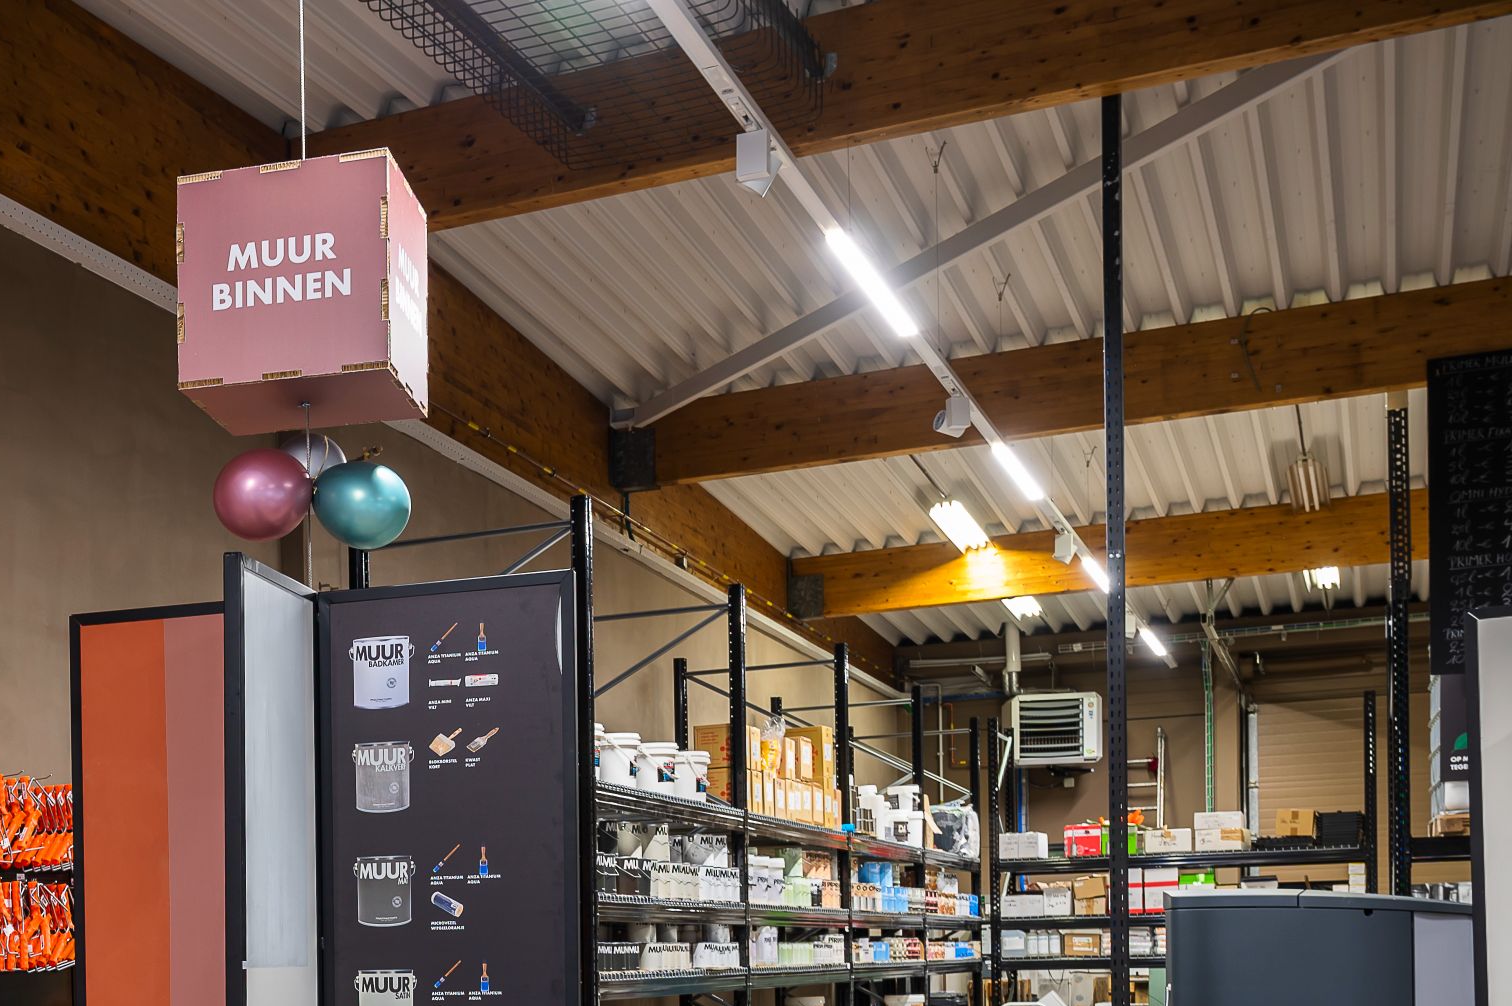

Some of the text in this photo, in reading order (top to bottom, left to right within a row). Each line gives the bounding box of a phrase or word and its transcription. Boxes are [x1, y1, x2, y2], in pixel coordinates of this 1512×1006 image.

[227, 232, 336, 272] MUUR
[398, 243, 419, 298] MUUR
[212, 268, 351, 311] BINNEN
[355, 643, 404, 661] MUUR
[368, 659, 405, 668] BADKAMER
[358, 748, 406, 766] MUUR
[359, 862, 408, 880] MUUR
[362, 977, 410, 993] MUUR
